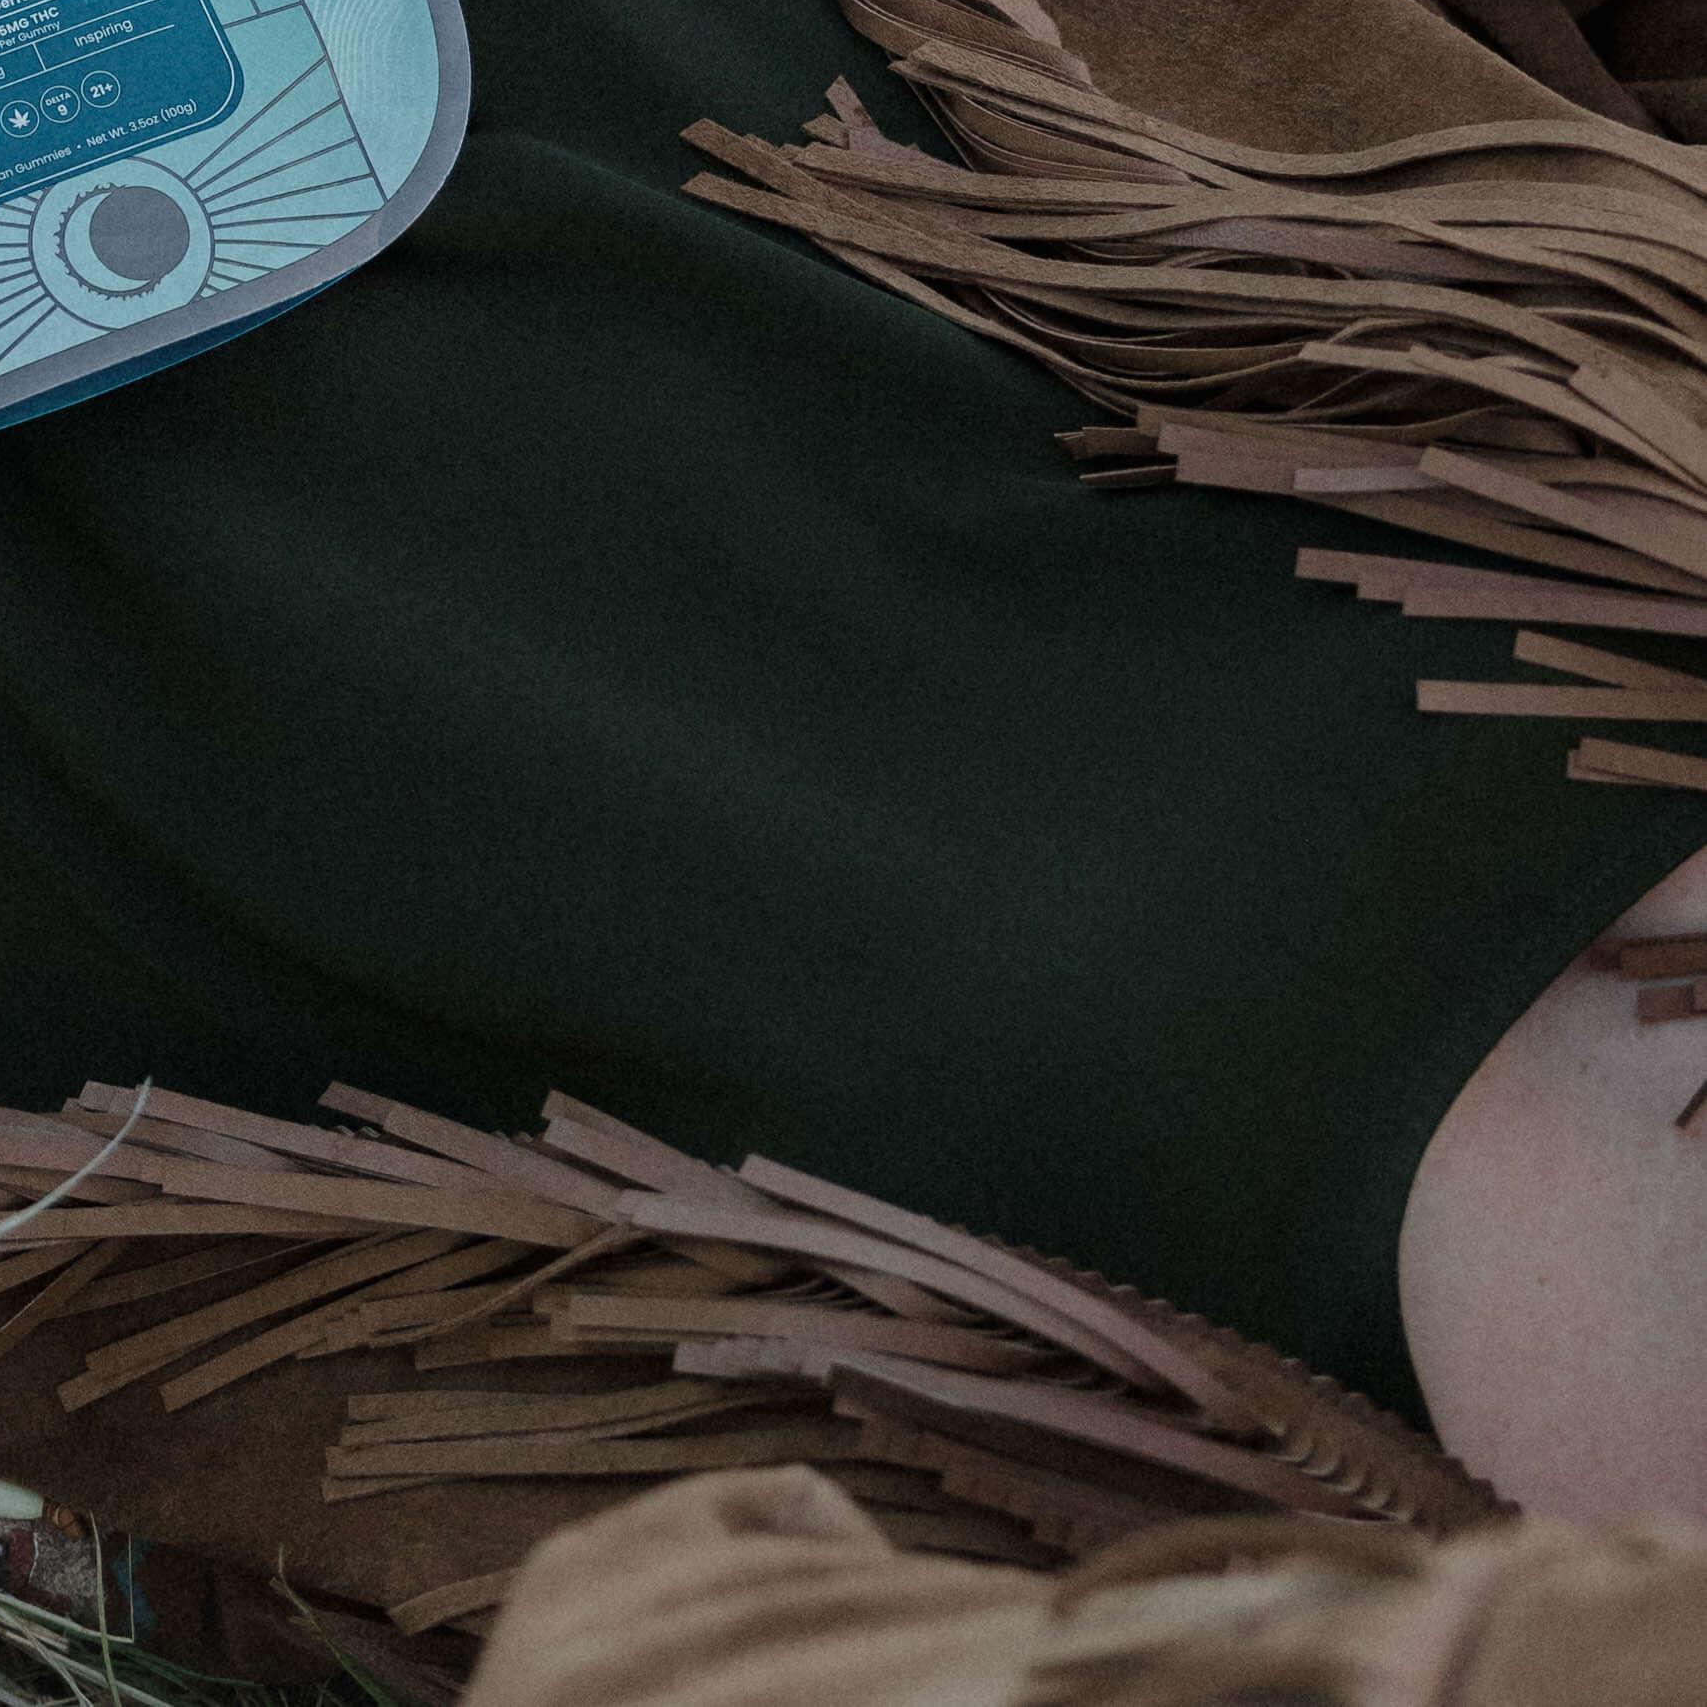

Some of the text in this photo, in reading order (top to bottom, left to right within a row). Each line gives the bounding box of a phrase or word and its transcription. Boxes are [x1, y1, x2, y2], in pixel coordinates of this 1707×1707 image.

[30, 6, 60, 26] THC
[0, 21, 62, 49] Per Gummy
[74, 19, 133, 47] Inspiring
[44, 92, 71, 107] DELTA
[89, 82, 114, 99] 21+
[57, 104, 68, 116] 9
[14, 147, 72, 176] Gummies
[86, 133, 107, 148] Net
[107, 124, 129, 140] Wt.
[128, 115, 160, 133] 3.5oz
[160, 98, 197, 122] (100g)
